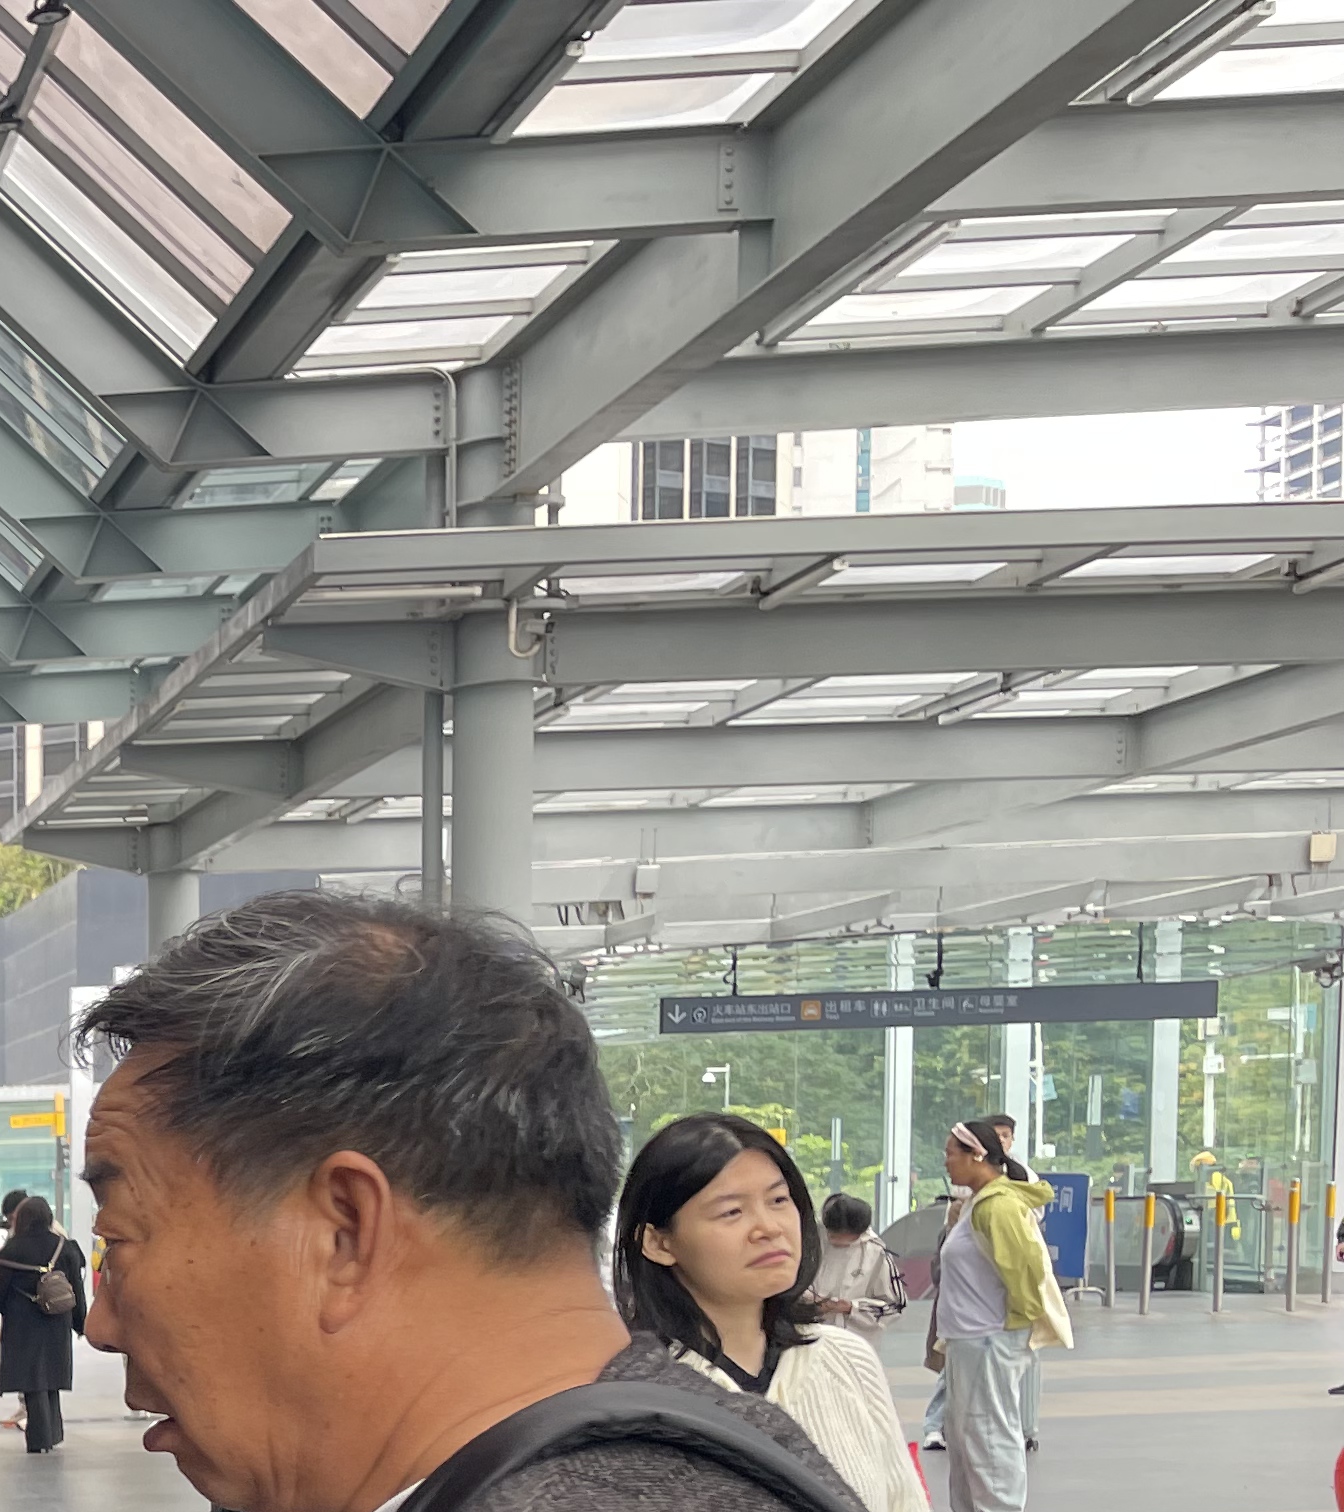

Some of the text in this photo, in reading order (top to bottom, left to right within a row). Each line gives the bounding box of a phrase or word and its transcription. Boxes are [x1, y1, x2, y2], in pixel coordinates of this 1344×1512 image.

[825, 1000, 866, 1013] 出租车
[915, 997, 955, 1010] 卫生间
